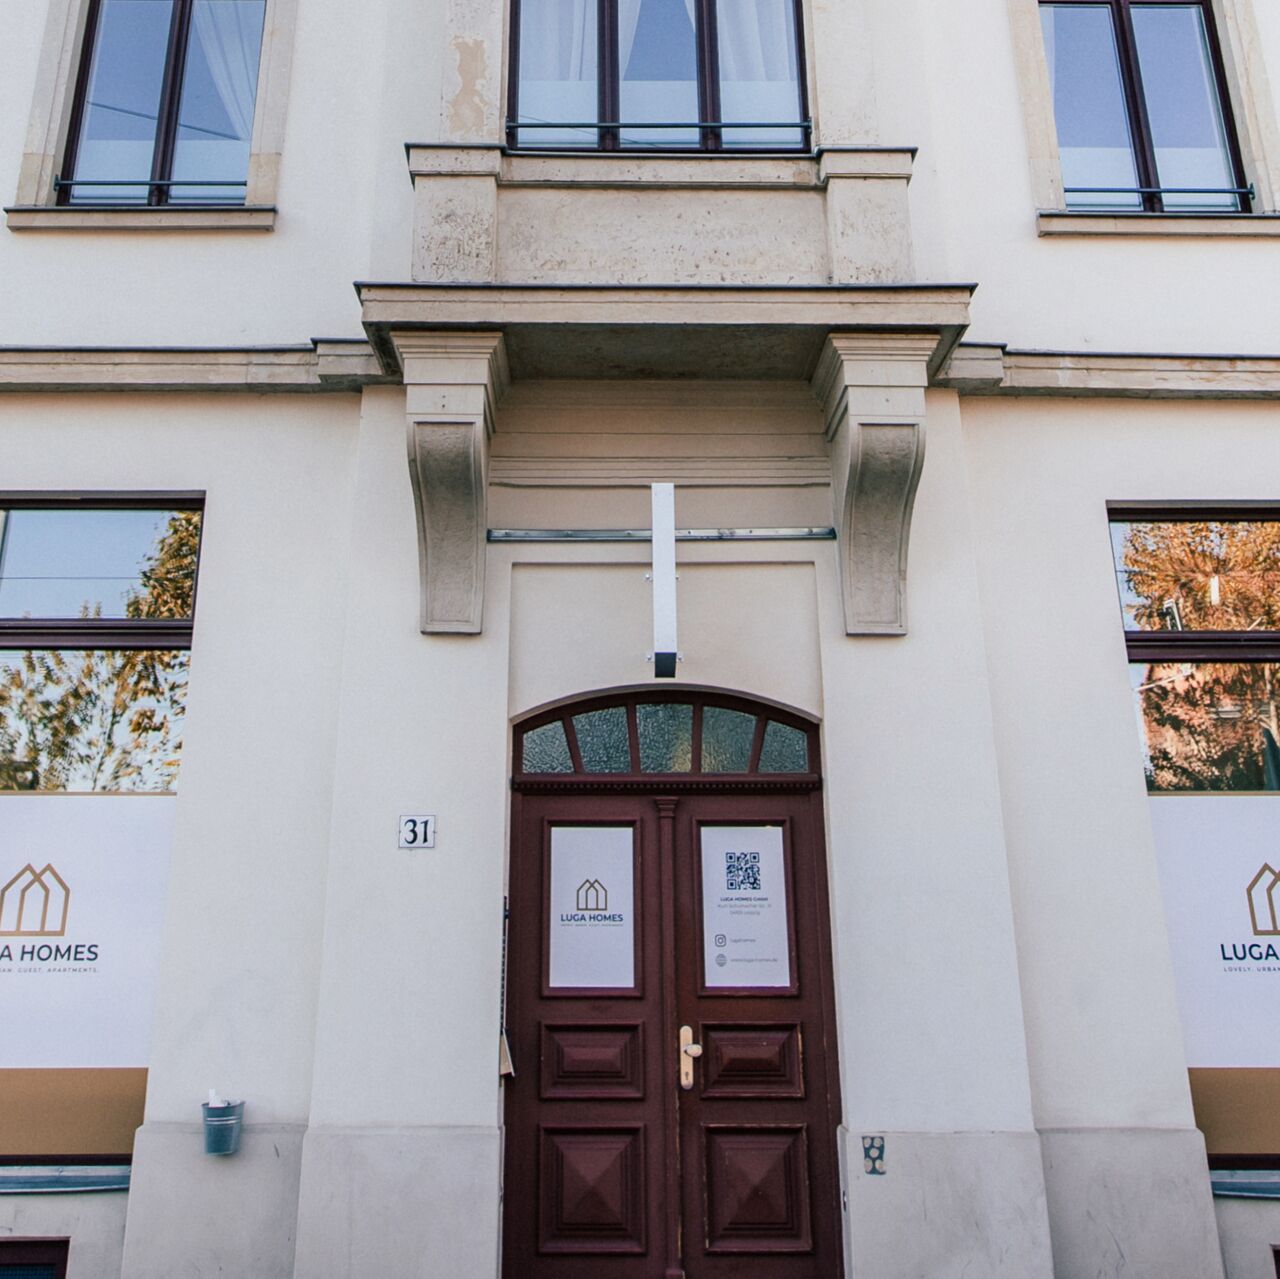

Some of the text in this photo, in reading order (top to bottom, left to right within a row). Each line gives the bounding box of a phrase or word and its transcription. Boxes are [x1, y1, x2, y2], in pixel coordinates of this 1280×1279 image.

[404, 818, 430, 845] 31
[560, 913, 624, 922] LUGA HOMES
[20, 944, 99, 962] HOMES
[1220, 943, 1280, 961] LUGA
